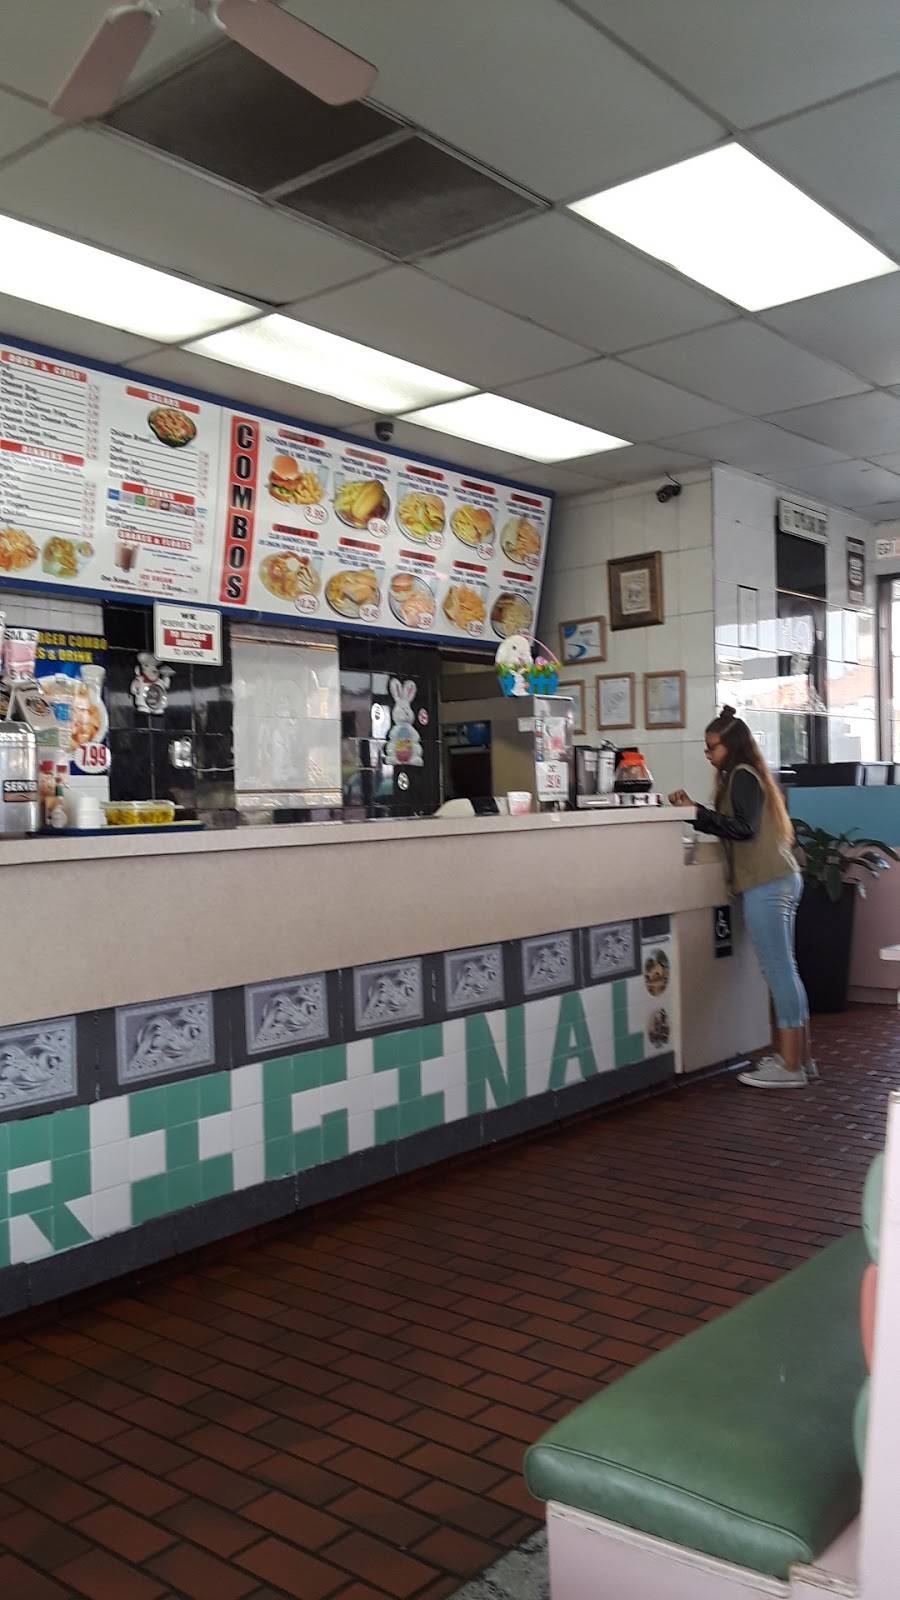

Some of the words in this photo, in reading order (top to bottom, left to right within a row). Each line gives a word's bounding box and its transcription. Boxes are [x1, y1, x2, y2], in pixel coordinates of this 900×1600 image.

[227, 424, 254, 600] COMBOS
[180, 612, 197, 620] WE
[68, 633, 108, 650] COMBO
[58, 648, 93, 664] DRINK
[80, 745, 106, 767] 7.99
